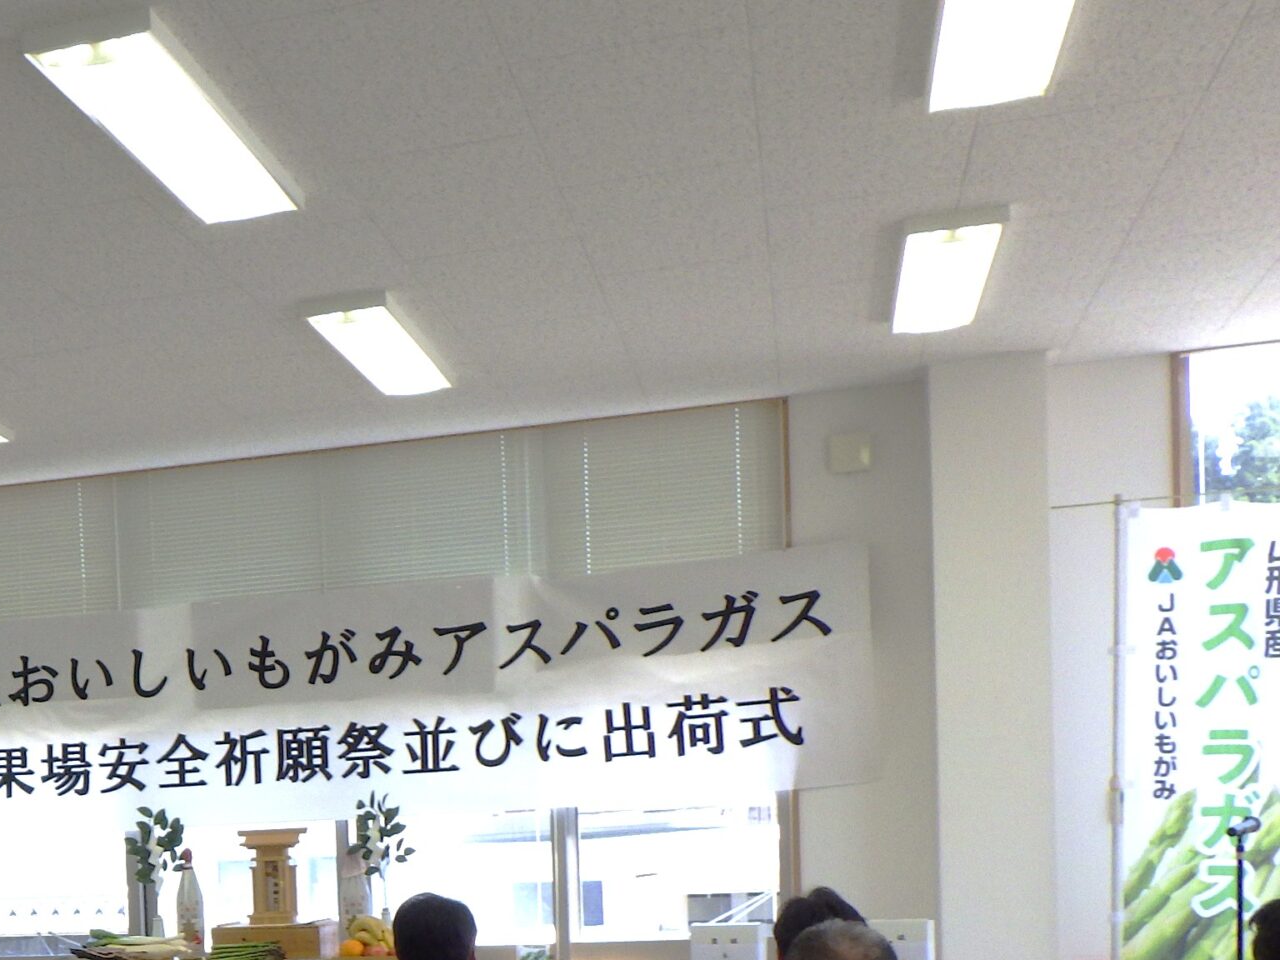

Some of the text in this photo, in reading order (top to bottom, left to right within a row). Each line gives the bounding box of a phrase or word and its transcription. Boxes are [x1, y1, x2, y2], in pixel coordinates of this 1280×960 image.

[1152, 593, 1178, 799] JAおいしいもがみ
